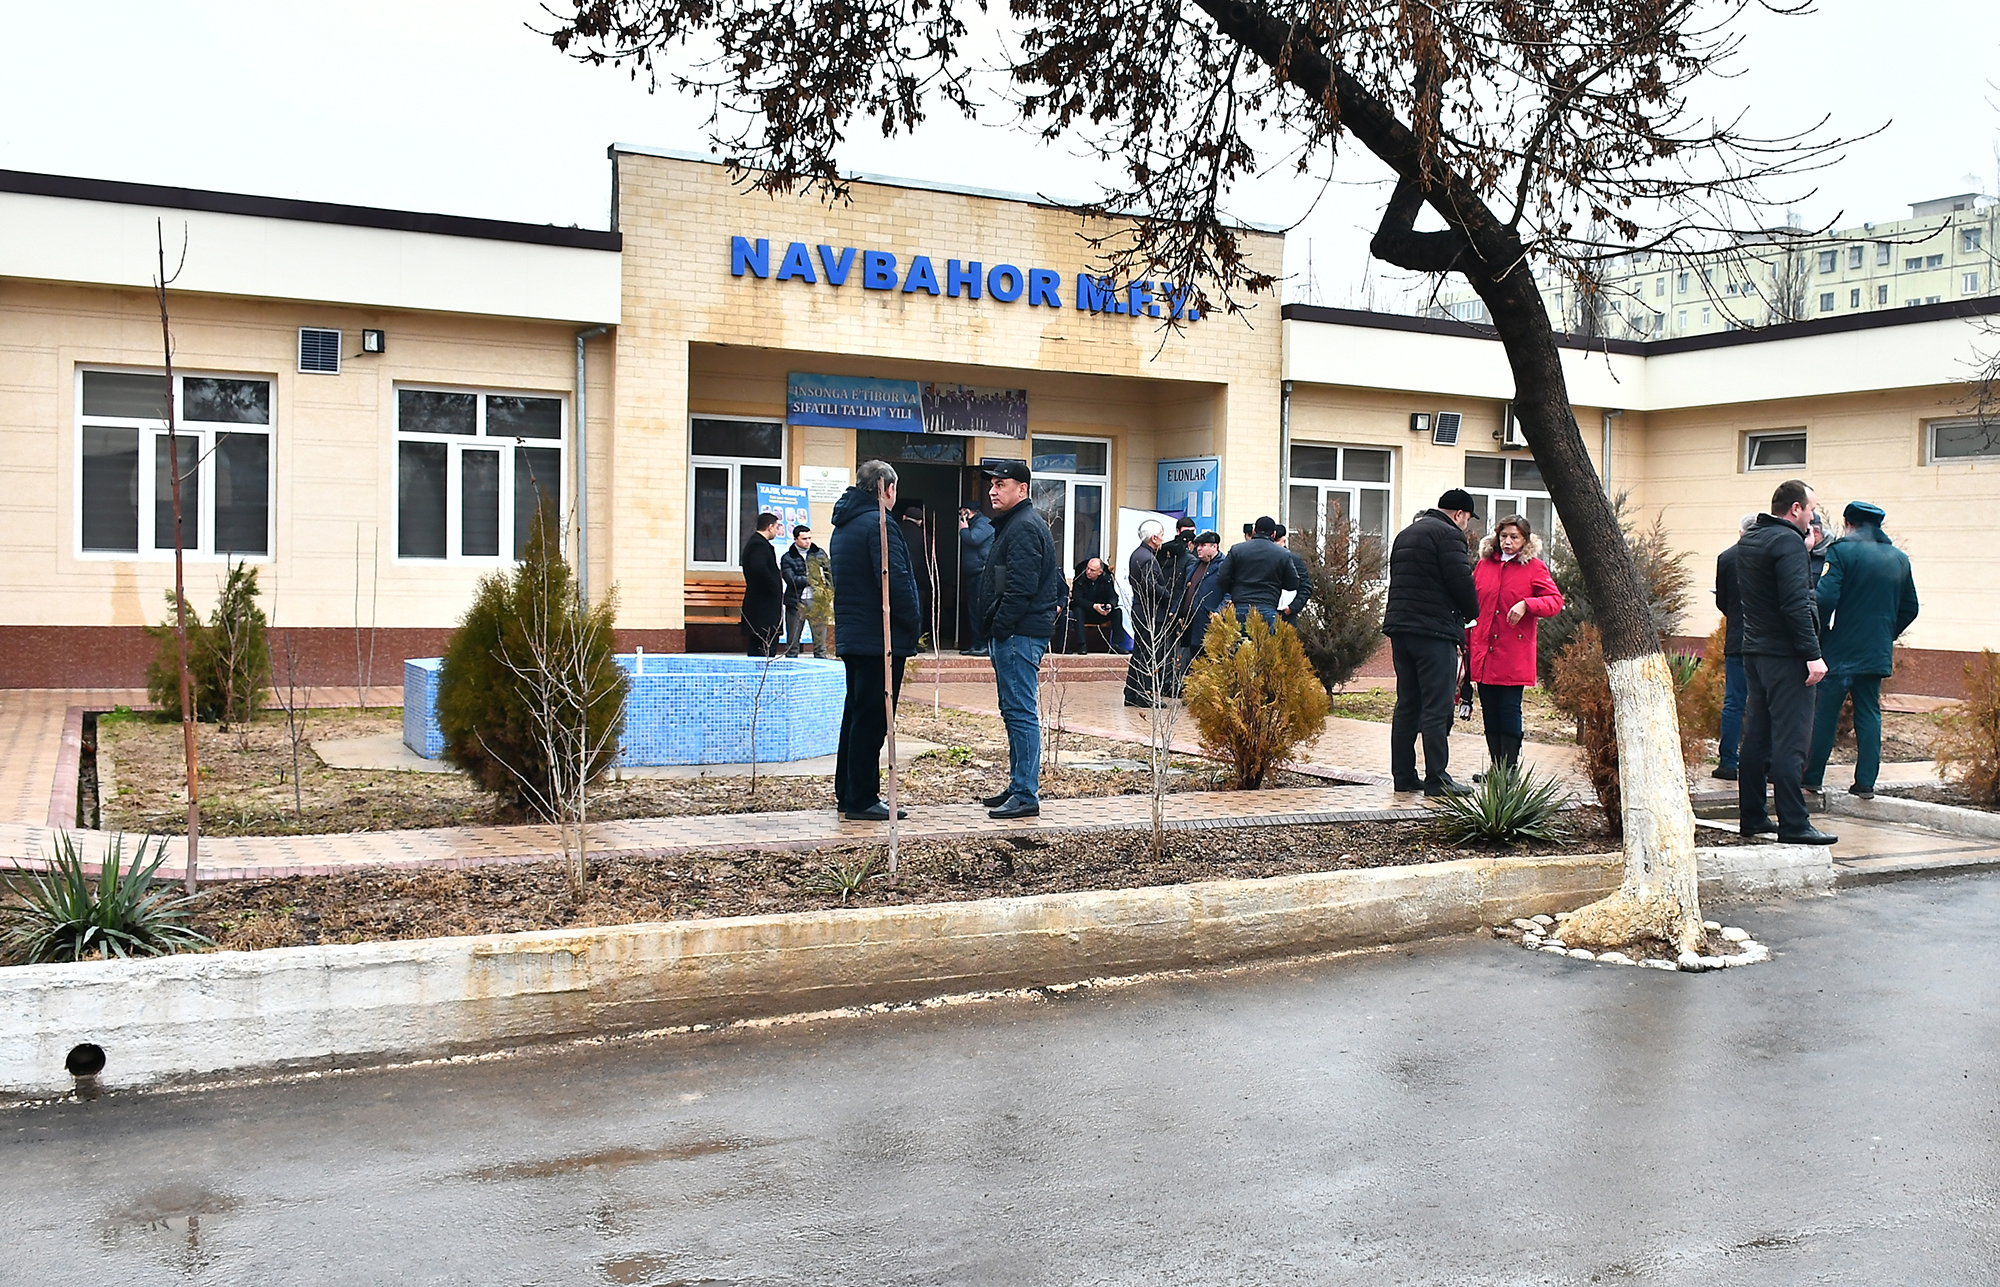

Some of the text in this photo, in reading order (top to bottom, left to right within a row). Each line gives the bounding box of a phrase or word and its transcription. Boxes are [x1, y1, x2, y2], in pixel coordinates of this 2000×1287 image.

[731, 235, 1062, 308] NAVBAHOR
[902, 393, 917, 404] VA
[793, 401, 838, 415] SIFATLI
[889, 407, 912, 420] YILI
